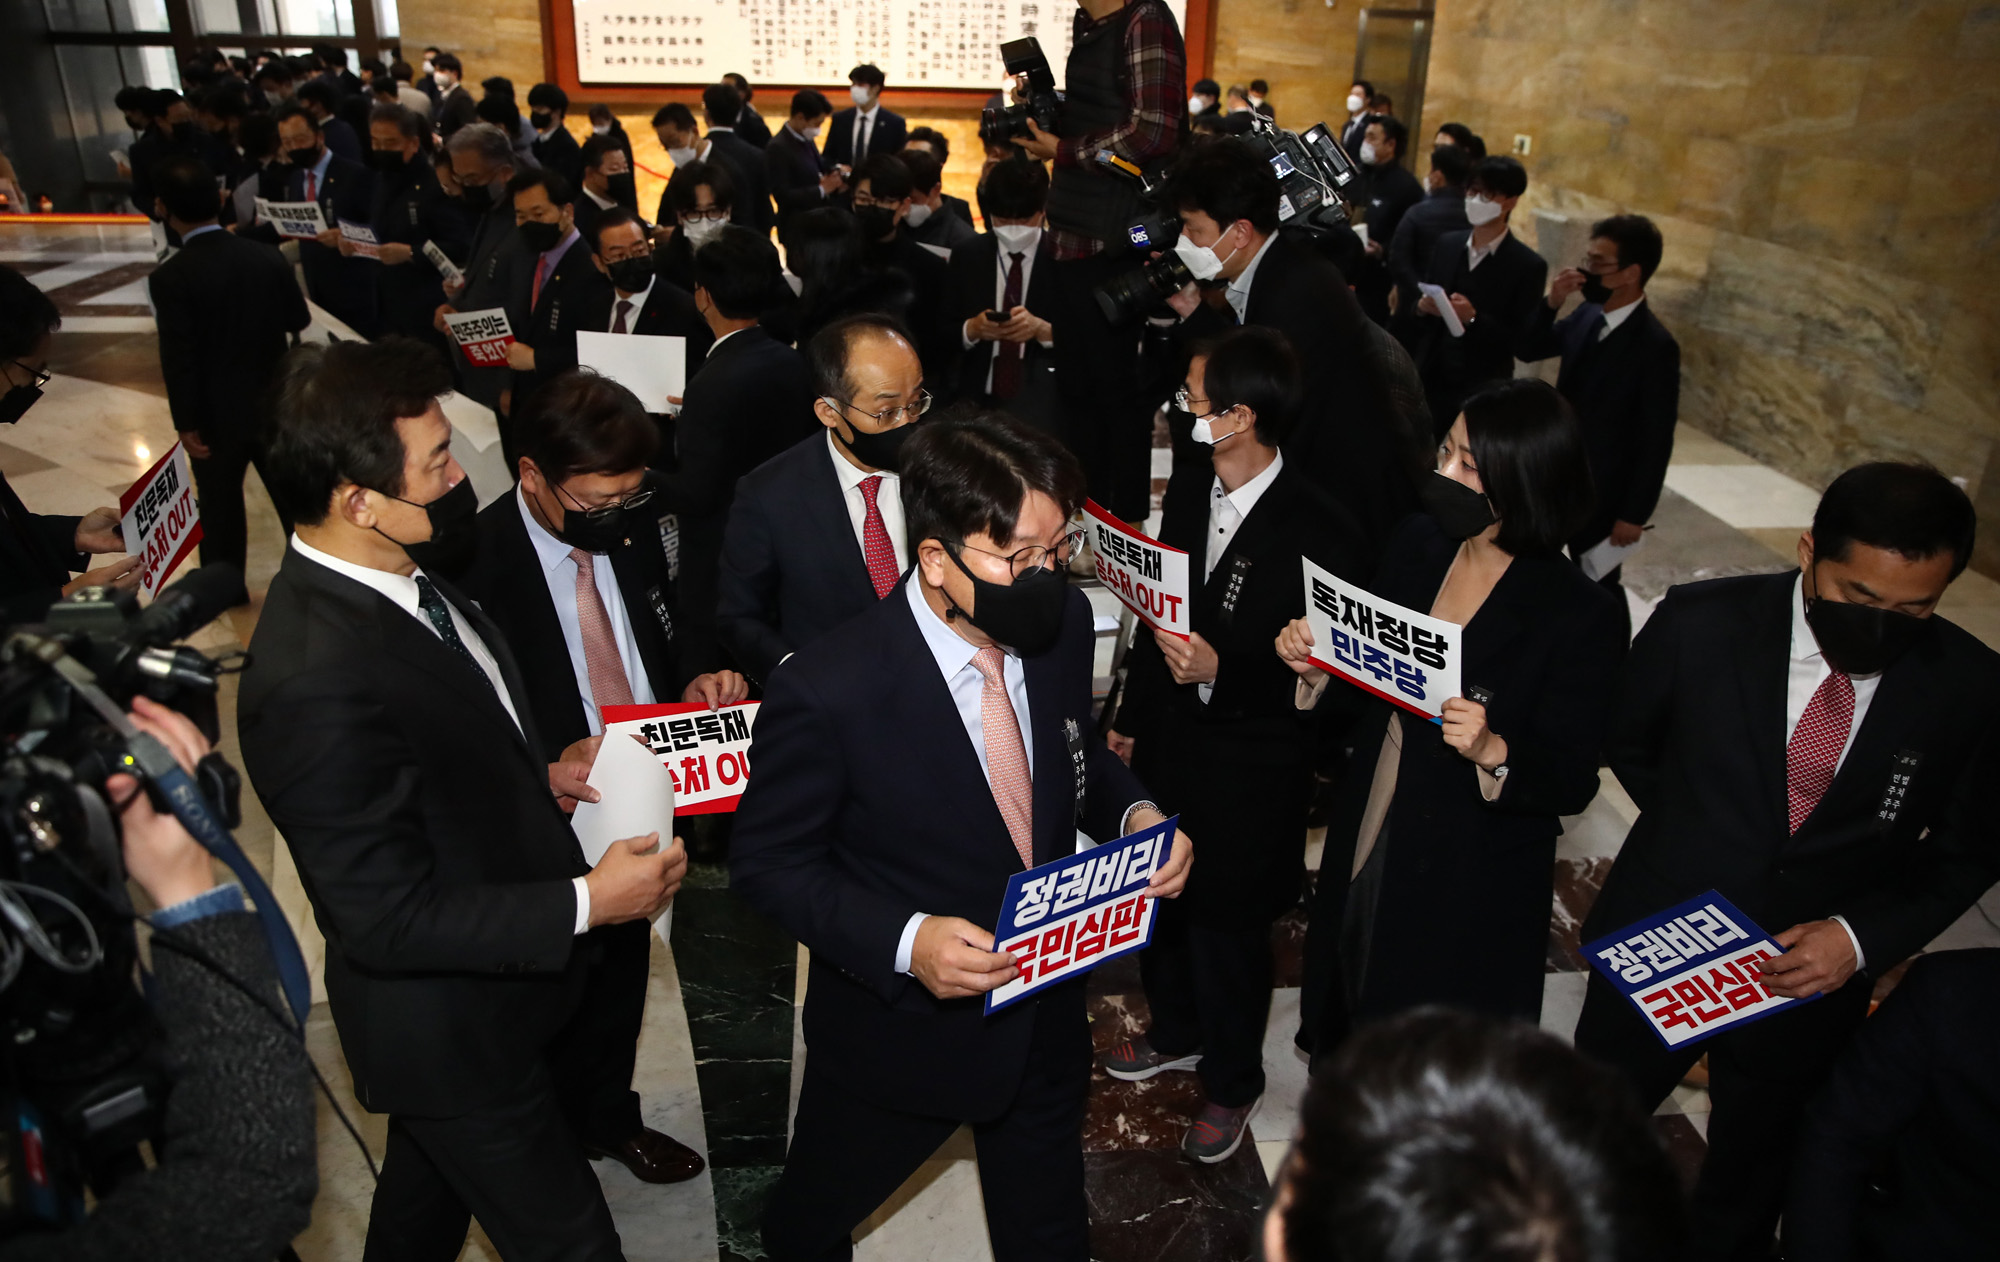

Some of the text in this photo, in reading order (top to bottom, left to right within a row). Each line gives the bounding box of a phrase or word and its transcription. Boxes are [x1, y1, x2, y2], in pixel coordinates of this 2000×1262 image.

[1130, 231, 1149, 244] OBS
[451, 315, 508, 343] 민주주의는
[134, 458, 179, 541] 친문독재
[167, 487, 193, 541] OUT
[1094, 549, 1183, 623] 공수처 OUT
[1096, 524, 1162, 582] 친문독재
[1312, 576, 1448, 671] 독재정당
[1330, 626, 1427, 701] 민주당
[640, 709, 751, 755] 친문독재
[1013, 831, 1166, 928] 정권비리
[1005, 894, 1147, 985] 국민심판
[1596, 903, 1750, 984] 정권비리
